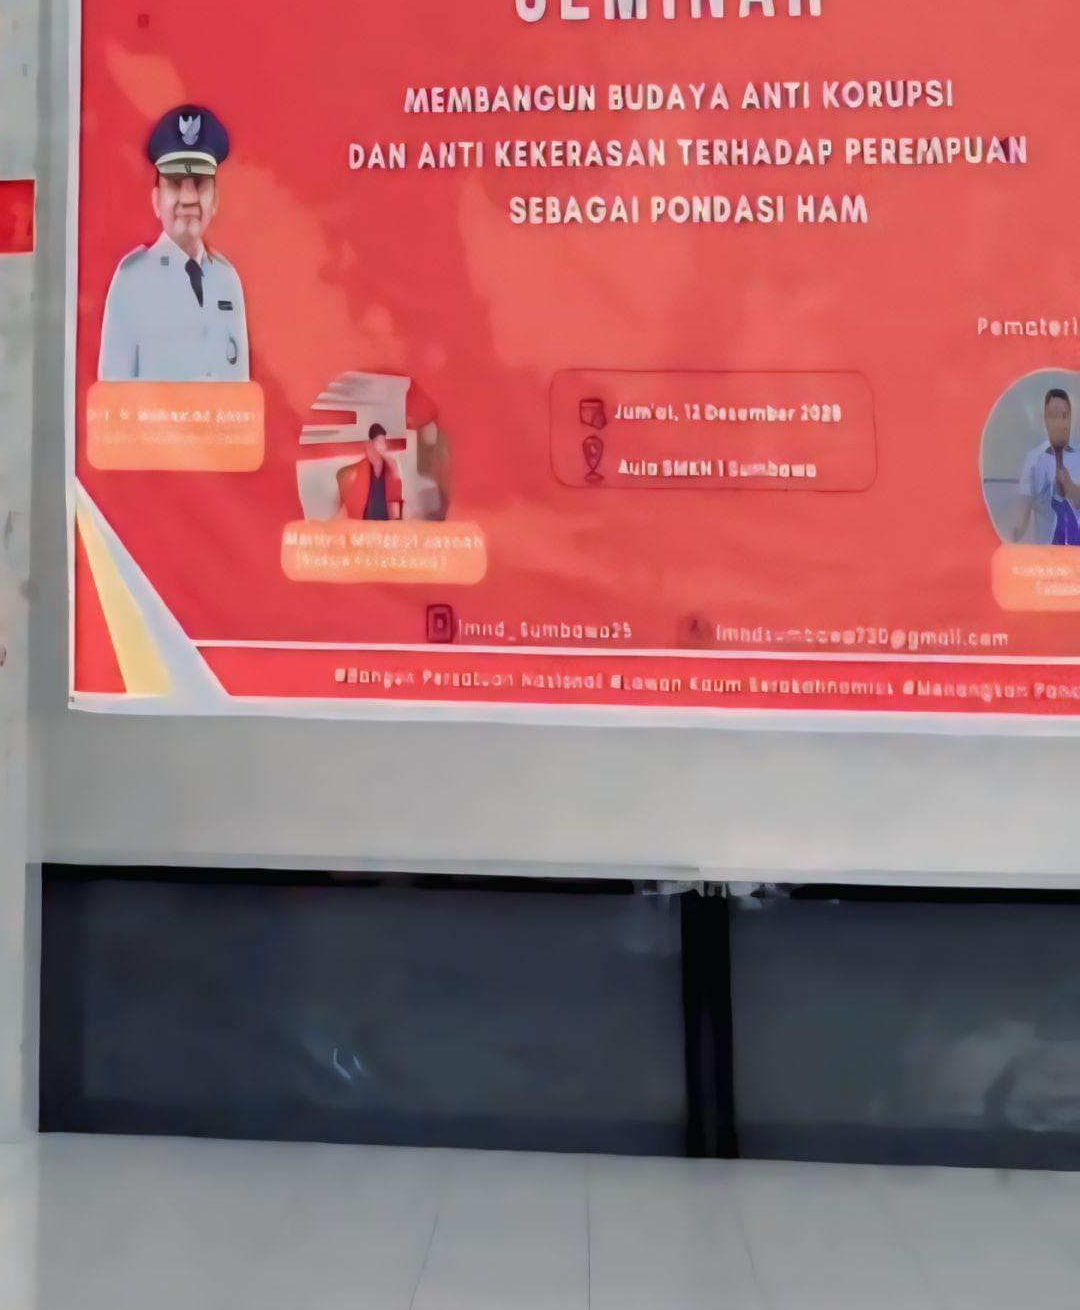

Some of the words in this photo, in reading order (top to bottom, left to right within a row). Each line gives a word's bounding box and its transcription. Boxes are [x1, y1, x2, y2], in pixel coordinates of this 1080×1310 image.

[404, 85, 596, 114] MEMBANGUN
[608, 83, 730, 112] BUDAYA
[740, 81, 810, 110] ANTI
[823, 79, 954, 109] KORUPSI
[348, 142, 406, 170] DAN
[417, 141, 483, 169] ANTI
[495, 139, 665, 169] KEKERASAN
[677, 137, 832, 167] TERHADAP
[846, 136, 1028, 165] PEREMPUAN
[509, 194, 639, 224] SEBAGAI
[650, 194, 784, 224] PONDASI
[798, 194, 868, 223] HAM
[684, 403, 701, 421] 12
[618, 458, 658, 476] Aula
